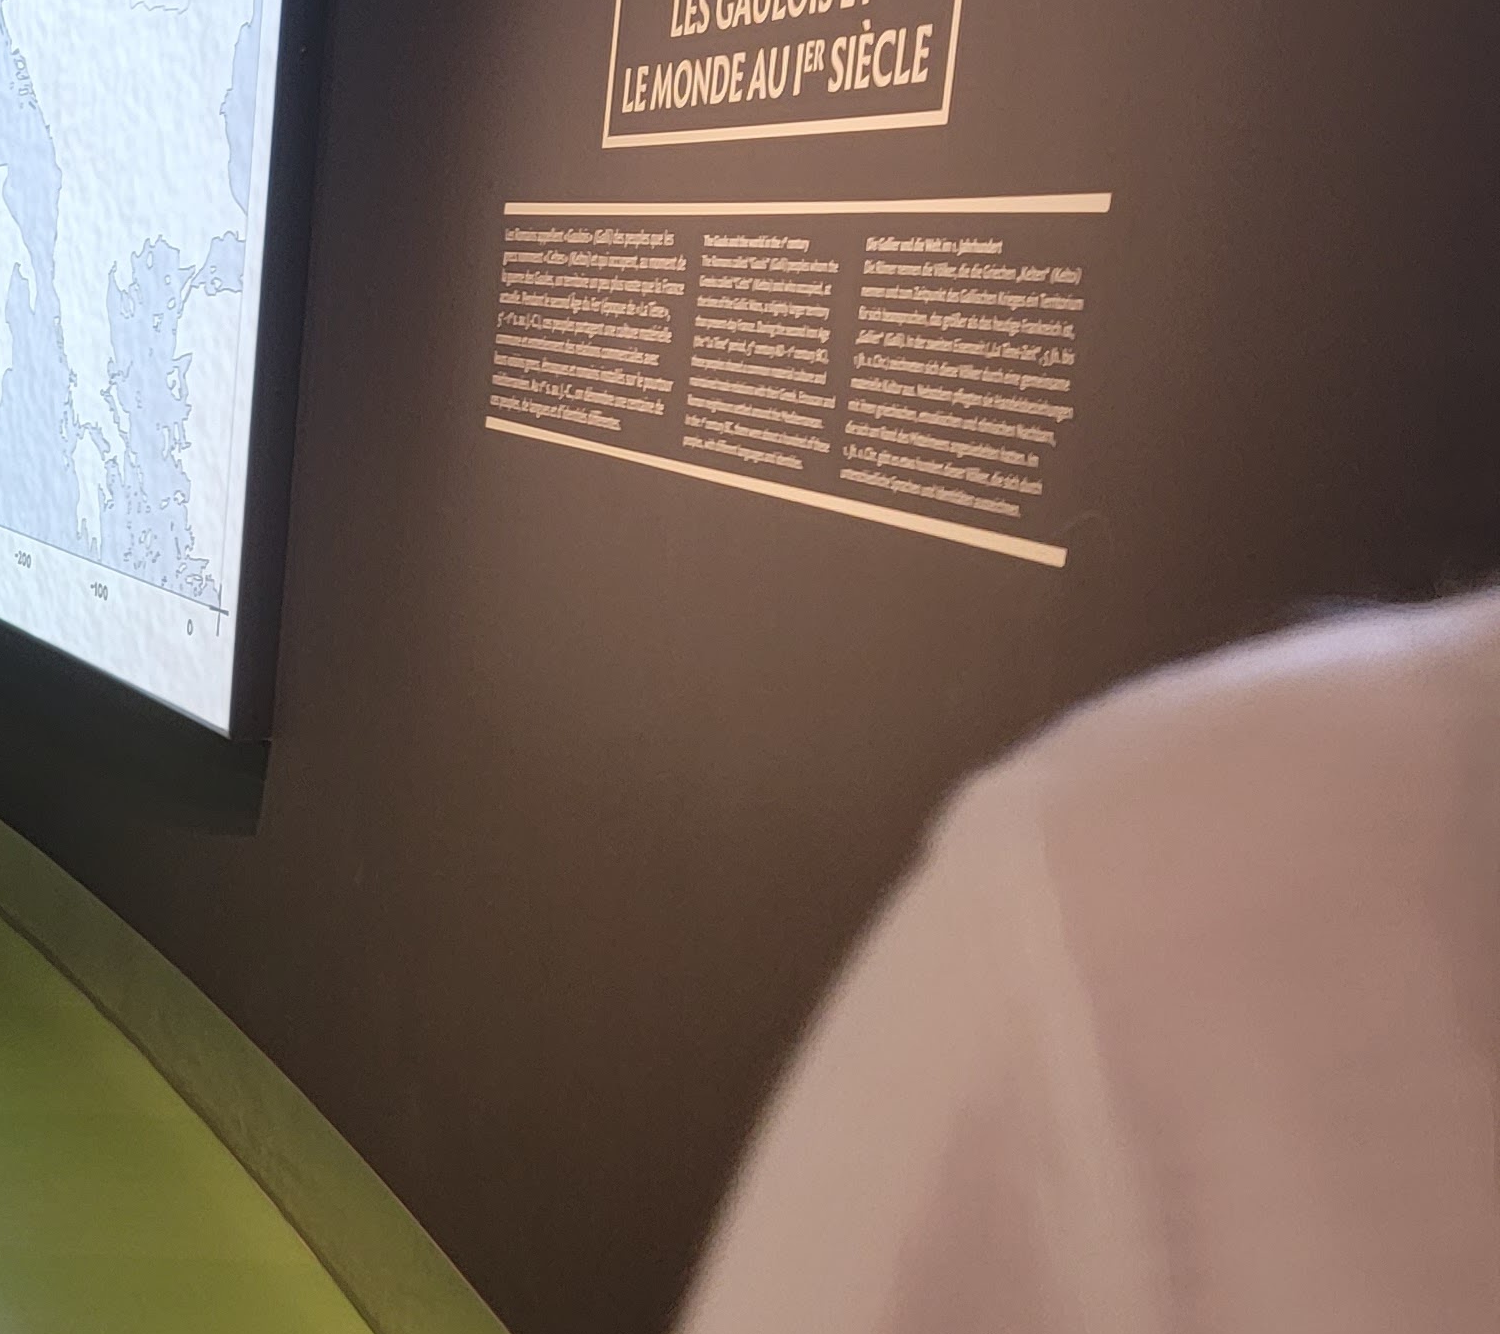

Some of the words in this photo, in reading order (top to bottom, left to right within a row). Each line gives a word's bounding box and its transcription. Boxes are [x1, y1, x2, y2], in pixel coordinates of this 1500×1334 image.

[621, 64, 650, 114] LE
[649, 51, 747, 111] MONDE
[745, 45, 791, 101] AU
[826, 18, 934, 93] SIÈCLE
[14, 550, 32, 568] -200
[90, 581, 109, 601] -100
[186, 618, 193, 636] 0
